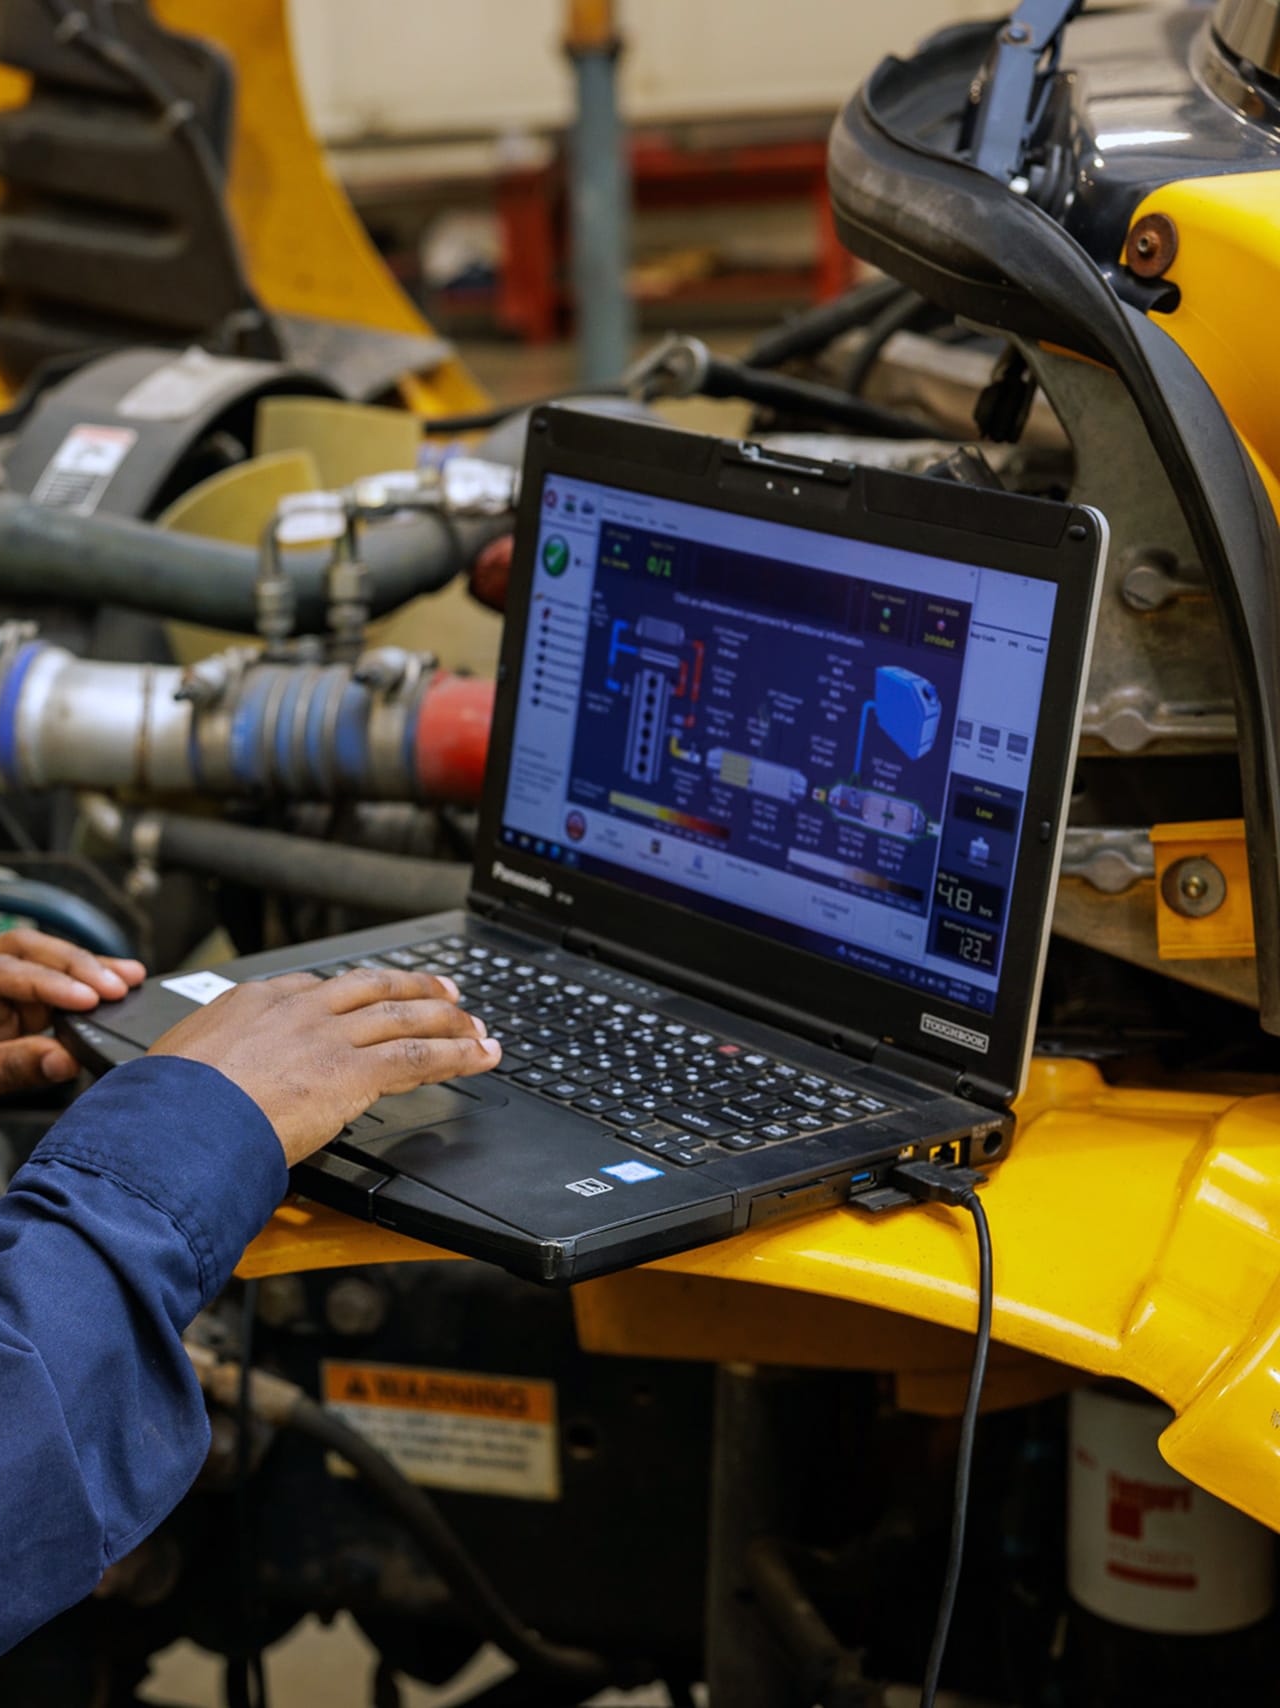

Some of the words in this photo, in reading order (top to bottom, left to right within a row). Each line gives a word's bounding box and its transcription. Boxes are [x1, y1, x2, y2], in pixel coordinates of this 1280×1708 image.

[646, 555, 672, 578] 0/1
[923, 1016, 987, 1051] TOUGHBOOK
[375, 1377, 531, 1415] WARNING
